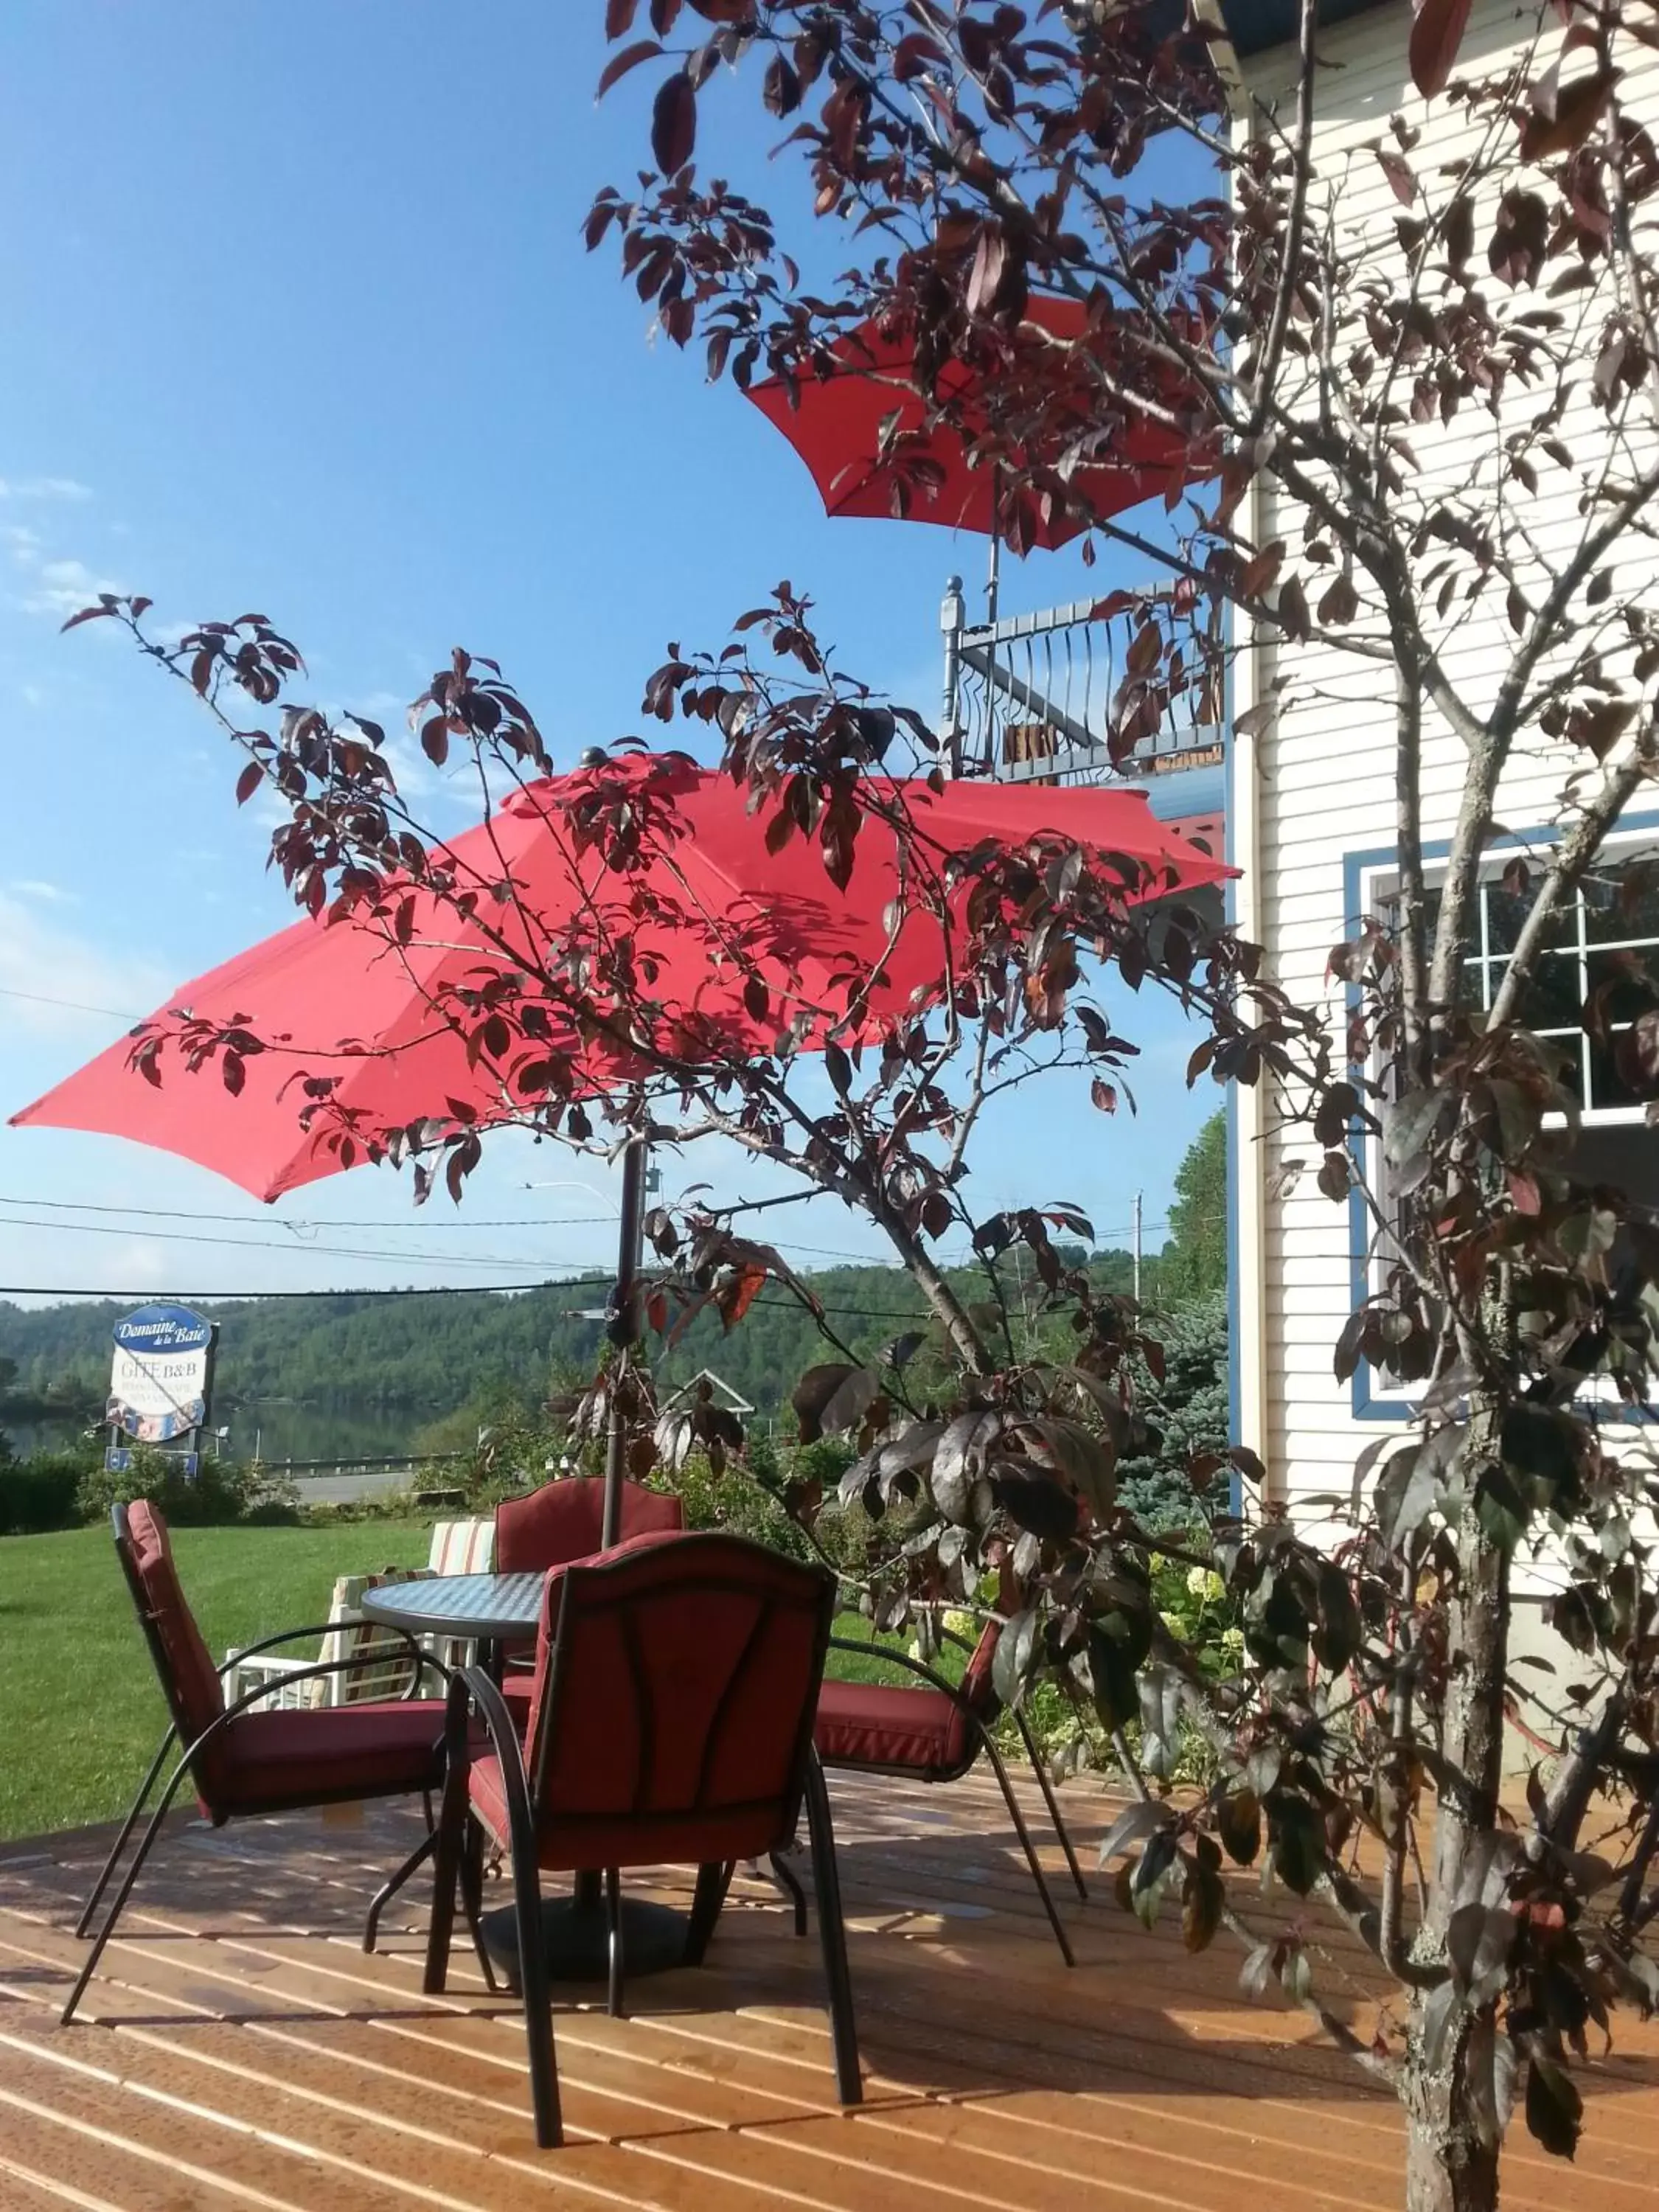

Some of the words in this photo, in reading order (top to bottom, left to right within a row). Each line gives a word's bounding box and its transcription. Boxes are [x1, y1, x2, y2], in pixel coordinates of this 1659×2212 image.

[119, 1318, 176, 1338] Domaine
[175, 1324, 205, 1343] Baie
[164, 1362, 196, 1379] B&B
